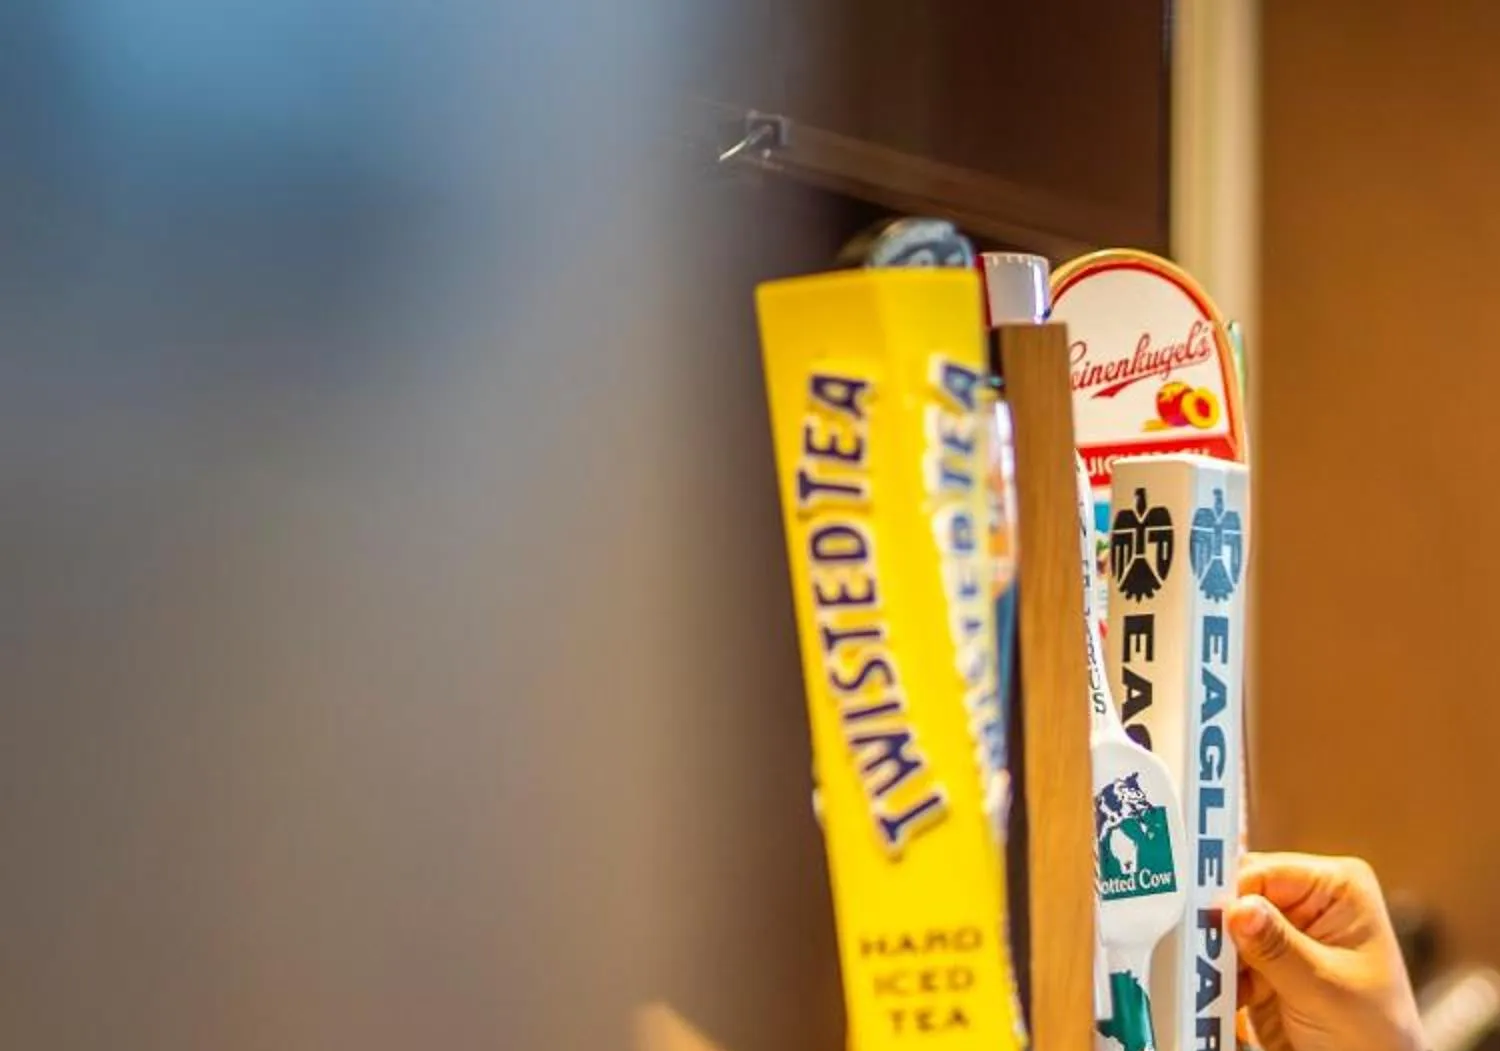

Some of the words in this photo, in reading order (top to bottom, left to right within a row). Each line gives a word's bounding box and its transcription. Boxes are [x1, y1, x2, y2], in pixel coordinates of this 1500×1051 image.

[797, 374, 867, 501] TEA
[810, 524, 942, 843] TWISTED
[1199, 615, 1229, 888] EAGLE
[1100, 872, 1137, 895] otted
[1139, 867, 1172, 889] Cow
[859, 926, 984, 959] HARD
[873, 966, 974, 999] ICED
[889, 1006, 970, 1037] TEA
